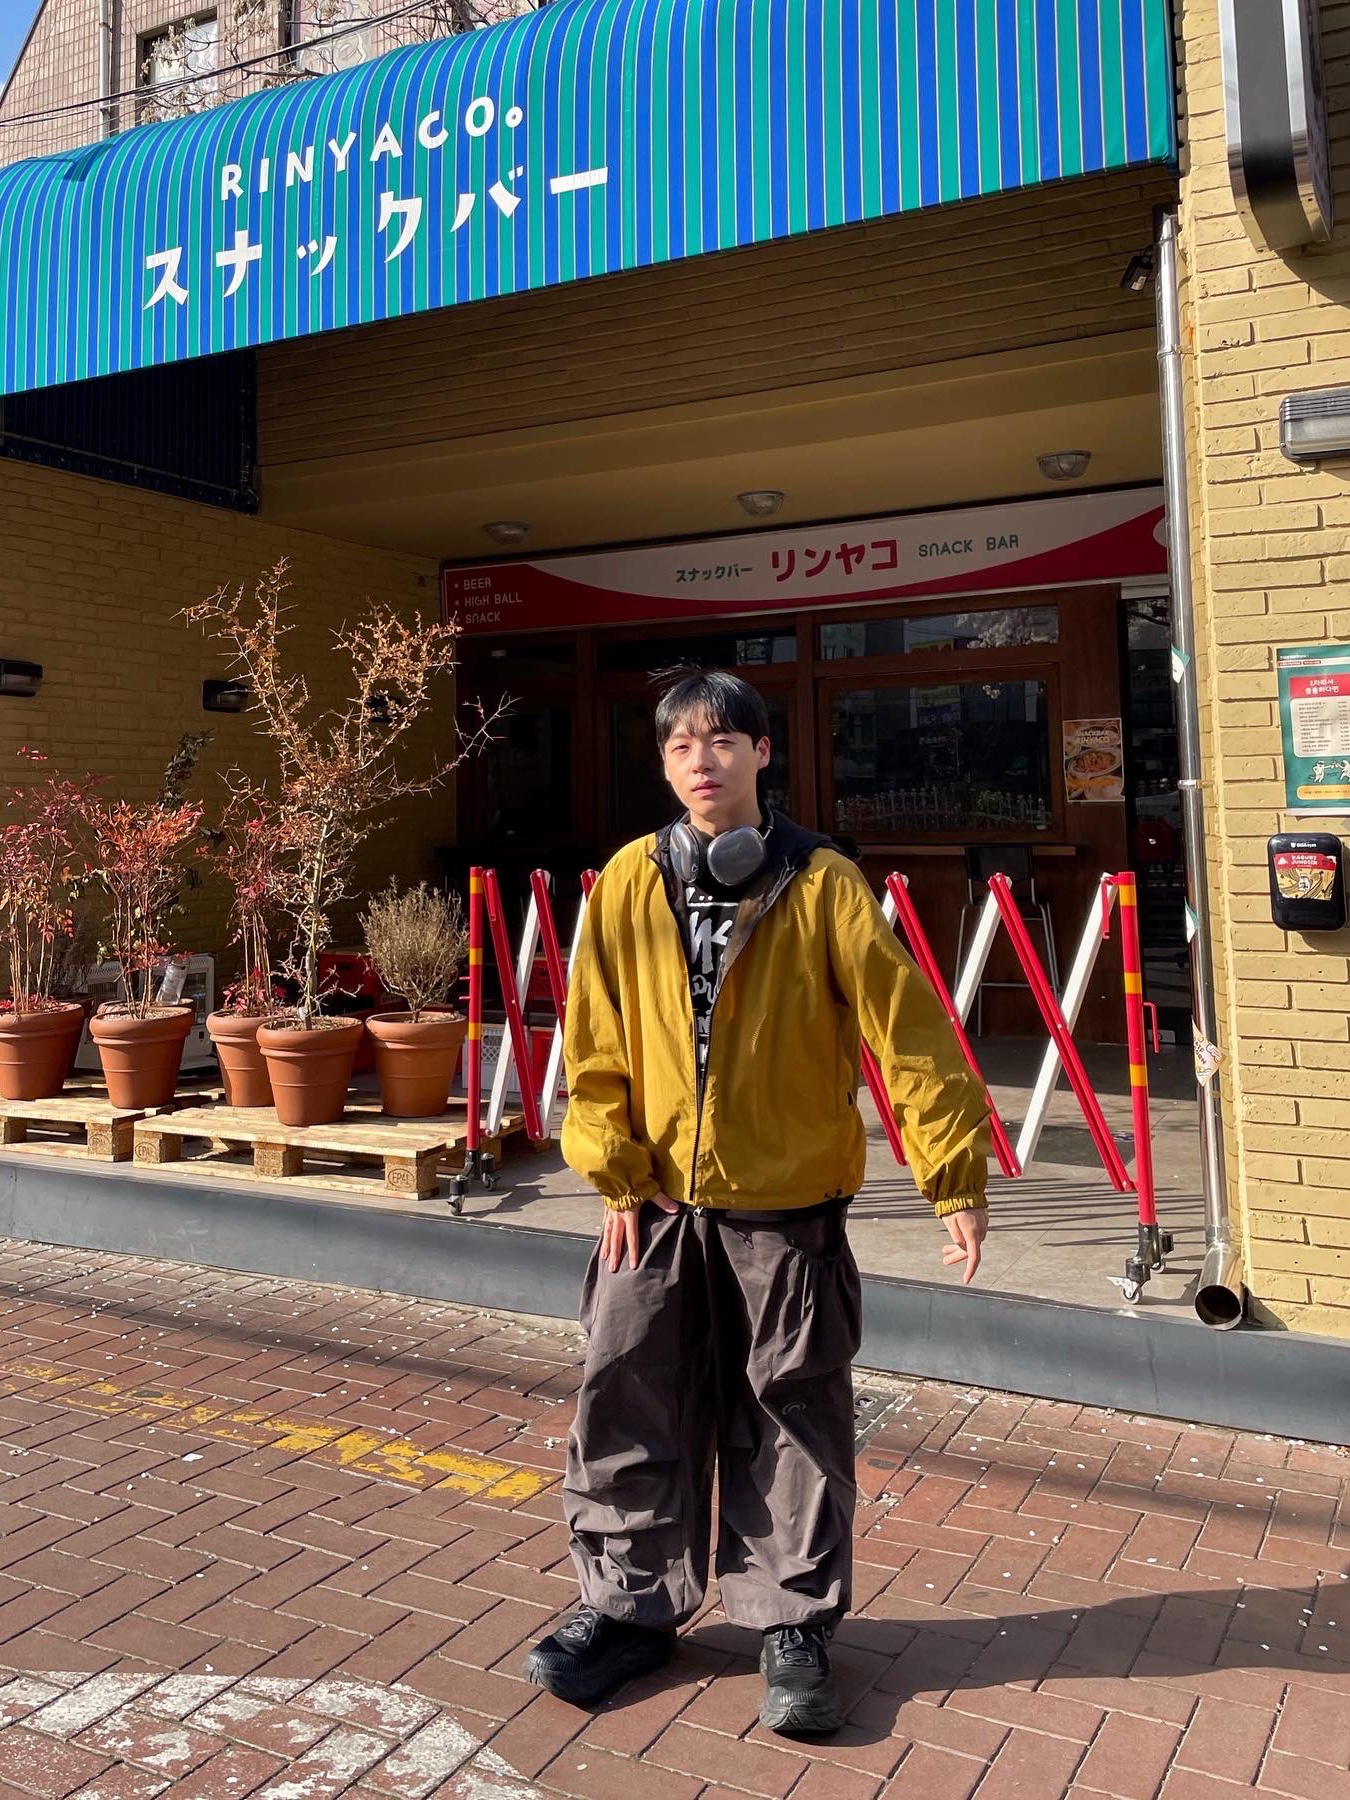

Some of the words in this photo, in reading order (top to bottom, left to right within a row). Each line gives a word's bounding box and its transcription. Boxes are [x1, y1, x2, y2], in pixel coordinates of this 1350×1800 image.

[142, 165, 609, 311] スナックバー
[675, 563, 754, 584] スナックバー
[770, 538, 899, 583] リンヤコ
[917, 539, 974, 558] SNACK
[985, 534, 1020, 551] BAR
[463, 576, 492, 591] BEER
[464, 593, 490, 608] HIGH
[493, 591, 523, 606] BALL
[465, 610, 502, 625] SNACK
